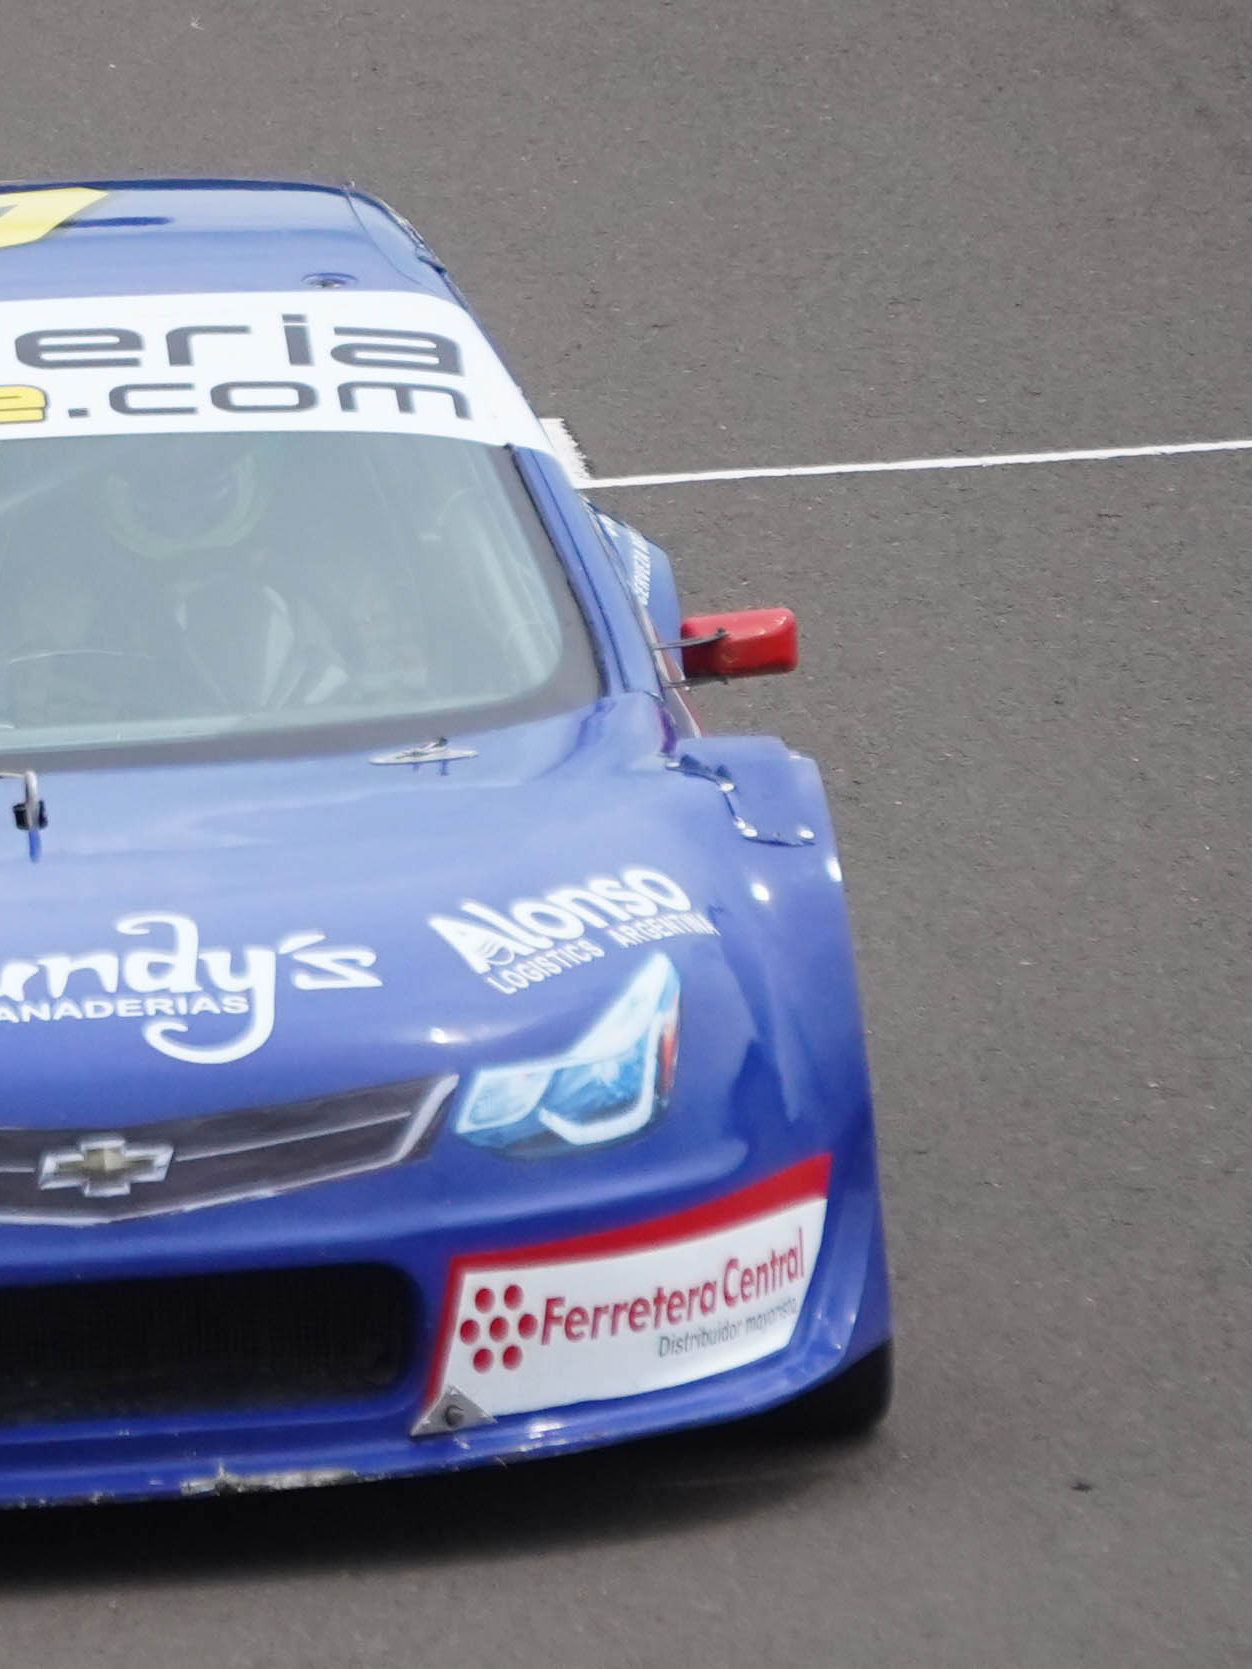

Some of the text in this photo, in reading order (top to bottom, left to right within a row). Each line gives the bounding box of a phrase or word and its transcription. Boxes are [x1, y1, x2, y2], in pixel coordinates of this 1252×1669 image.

[428, 867, 691, 975] Alonso
[487, 912, 721, 994] LOGISTICS ARGENTINA
[541, 1226, 805, 1346] Ferretera Central
[657, 1319, 742, 1358] Distribuidor
